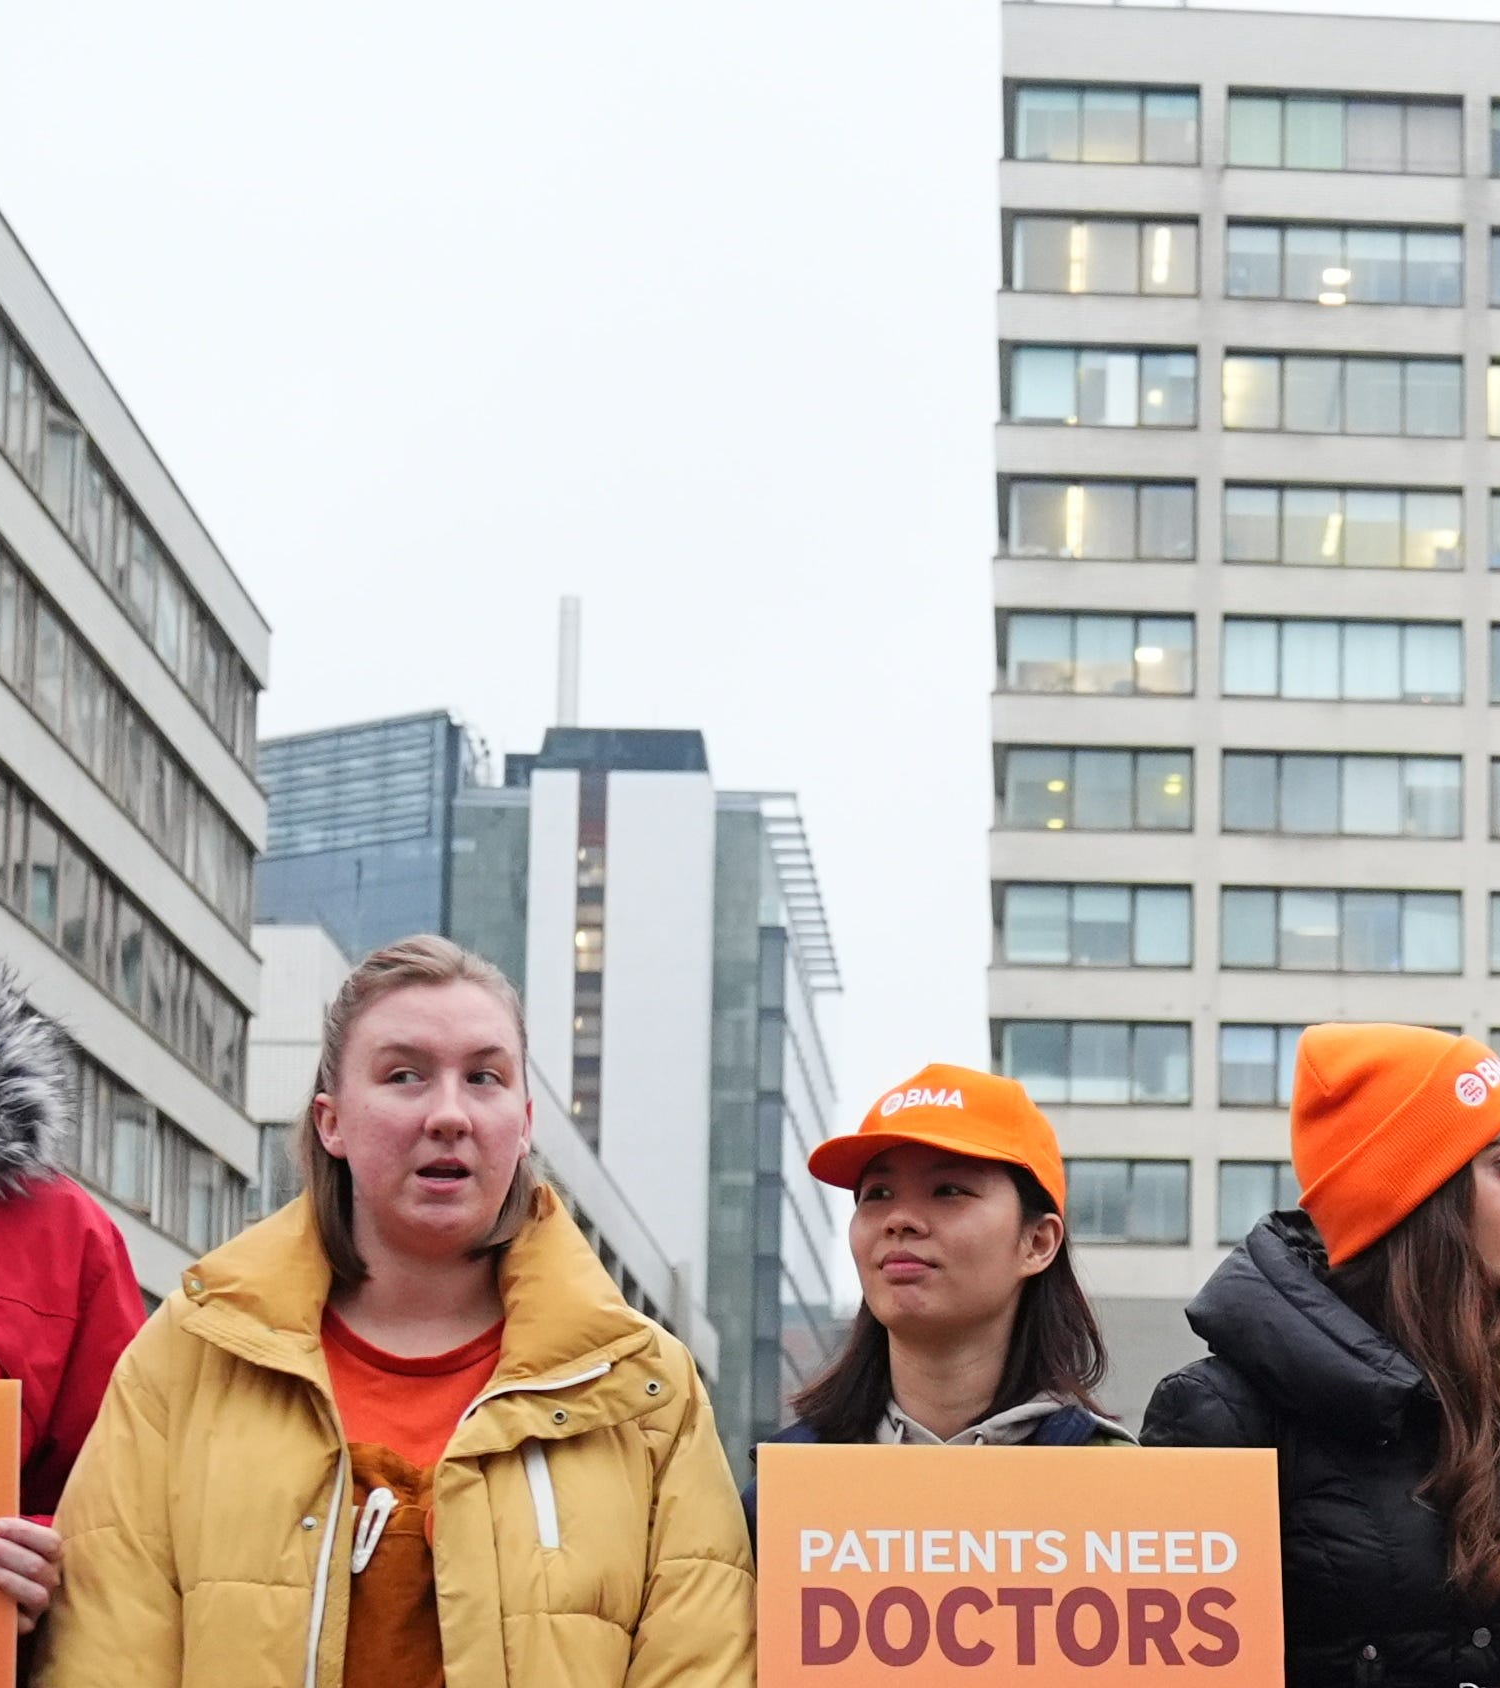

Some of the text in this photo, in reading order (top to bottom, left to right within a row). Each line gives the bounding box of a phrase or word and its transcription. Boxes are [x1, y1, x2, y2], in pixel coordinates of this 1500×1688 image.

[902, 1088, 964, 1109] BMA
[801, 1530, 1237, 1574] PATIENTS NEED
[801, 1586, 1240, 1666] DOCTORS
